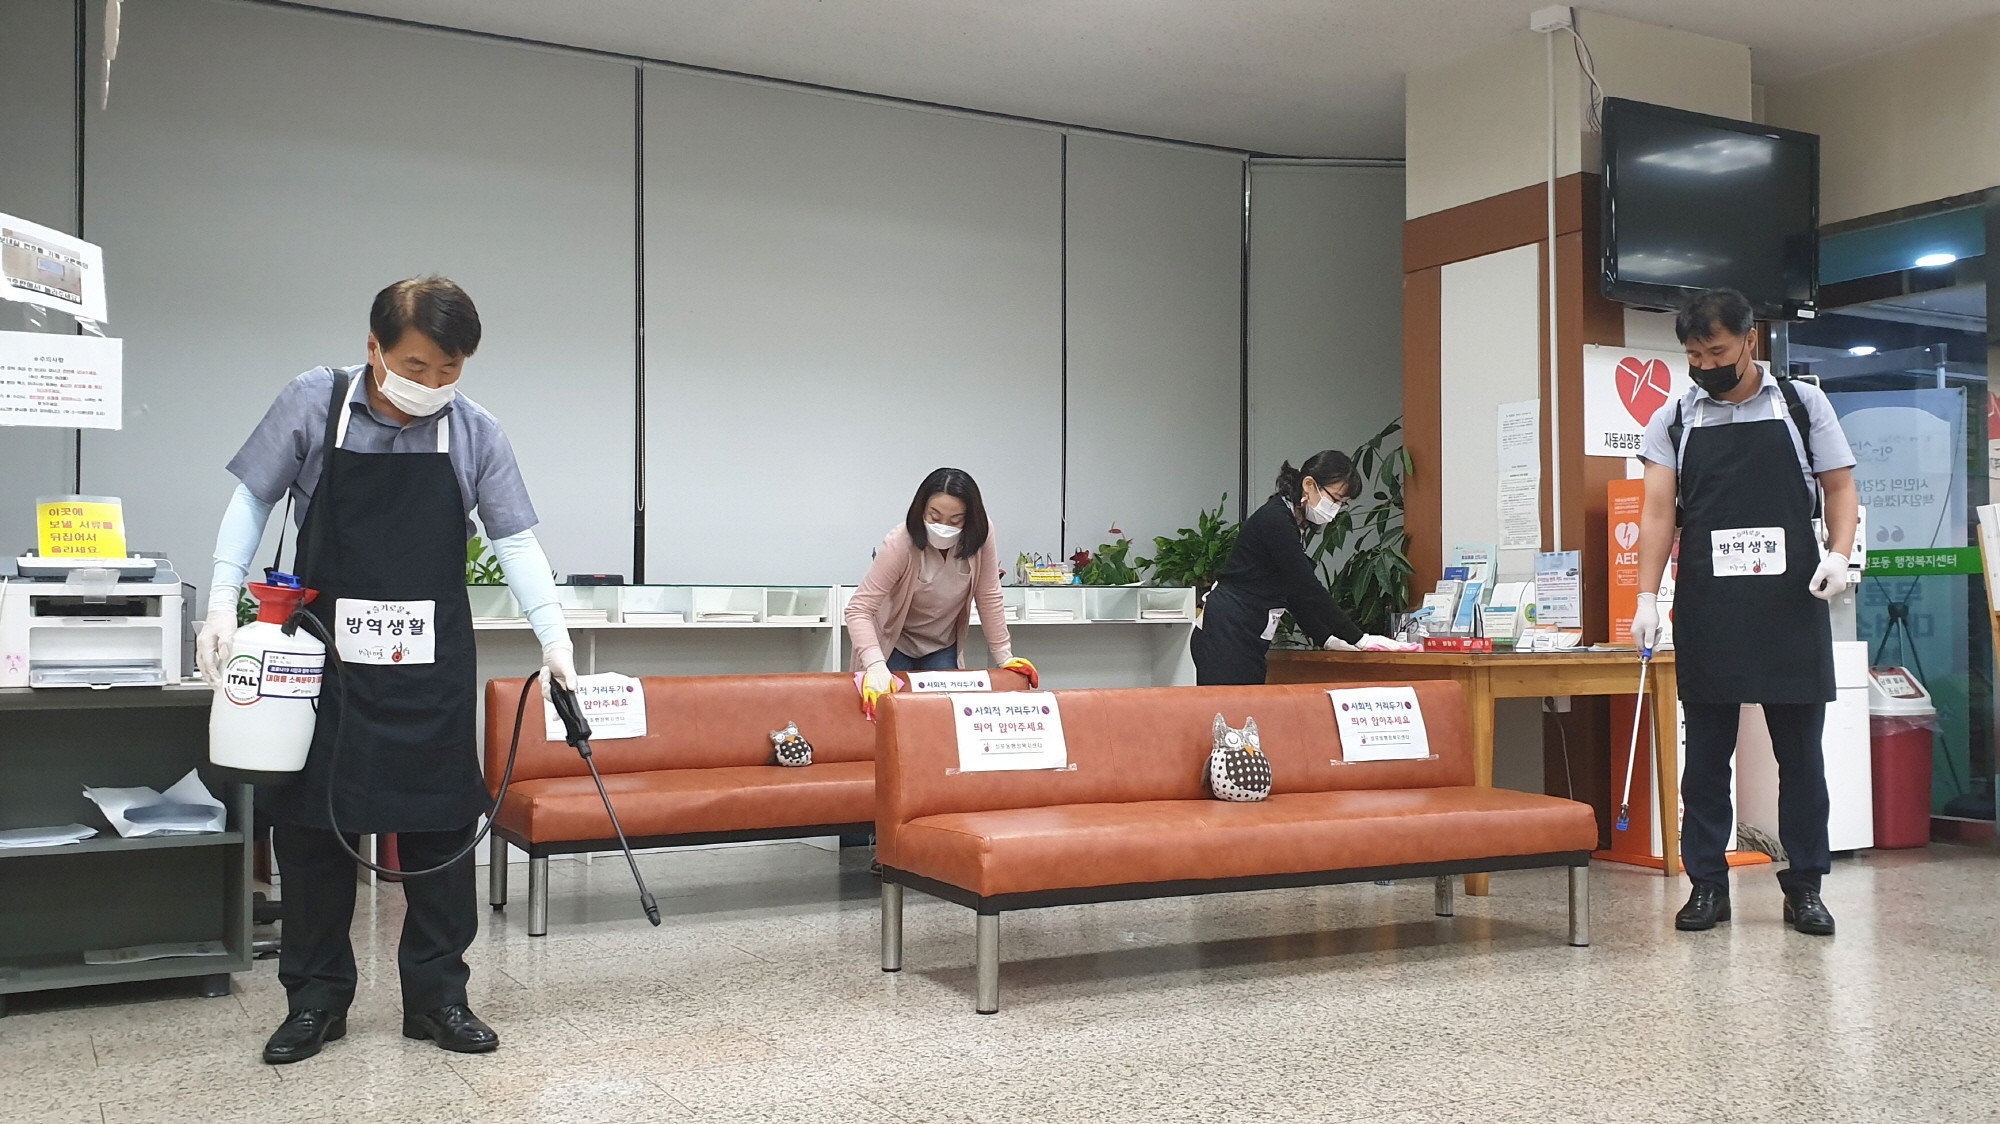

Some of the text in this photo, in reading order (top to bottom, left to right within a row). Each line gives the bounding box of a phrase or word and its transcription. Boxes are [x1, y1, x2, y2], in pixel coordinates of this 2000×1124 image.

[1604, 432, 1644, 450] 자동심장충
[49, 507, 83, 516] 이곳에
[50, 520, 73, 529] 보낼
[50, 532, 97, 541] 뒤집어서
[1719, 540, 1778, 555] 방역생활
[1895, 553, 1957, 569] 행정복지센터
[346, 617, 426, 636] 방역생활
[592, 685, 625, 695] 거리두기
[926, 680, 977, 689] 사회적 거리두기
[583, 698, 629, 710] 앉아주세요
[1351, 701, 1404, 711] 사회적 거리두기
[975, 705, 1040, 716] 사회적 거리두기
[1351, 715, 1410, 727] 띄어 앉아주세요
[973, 721, 1045, 734] 띄어 앉아주세요
